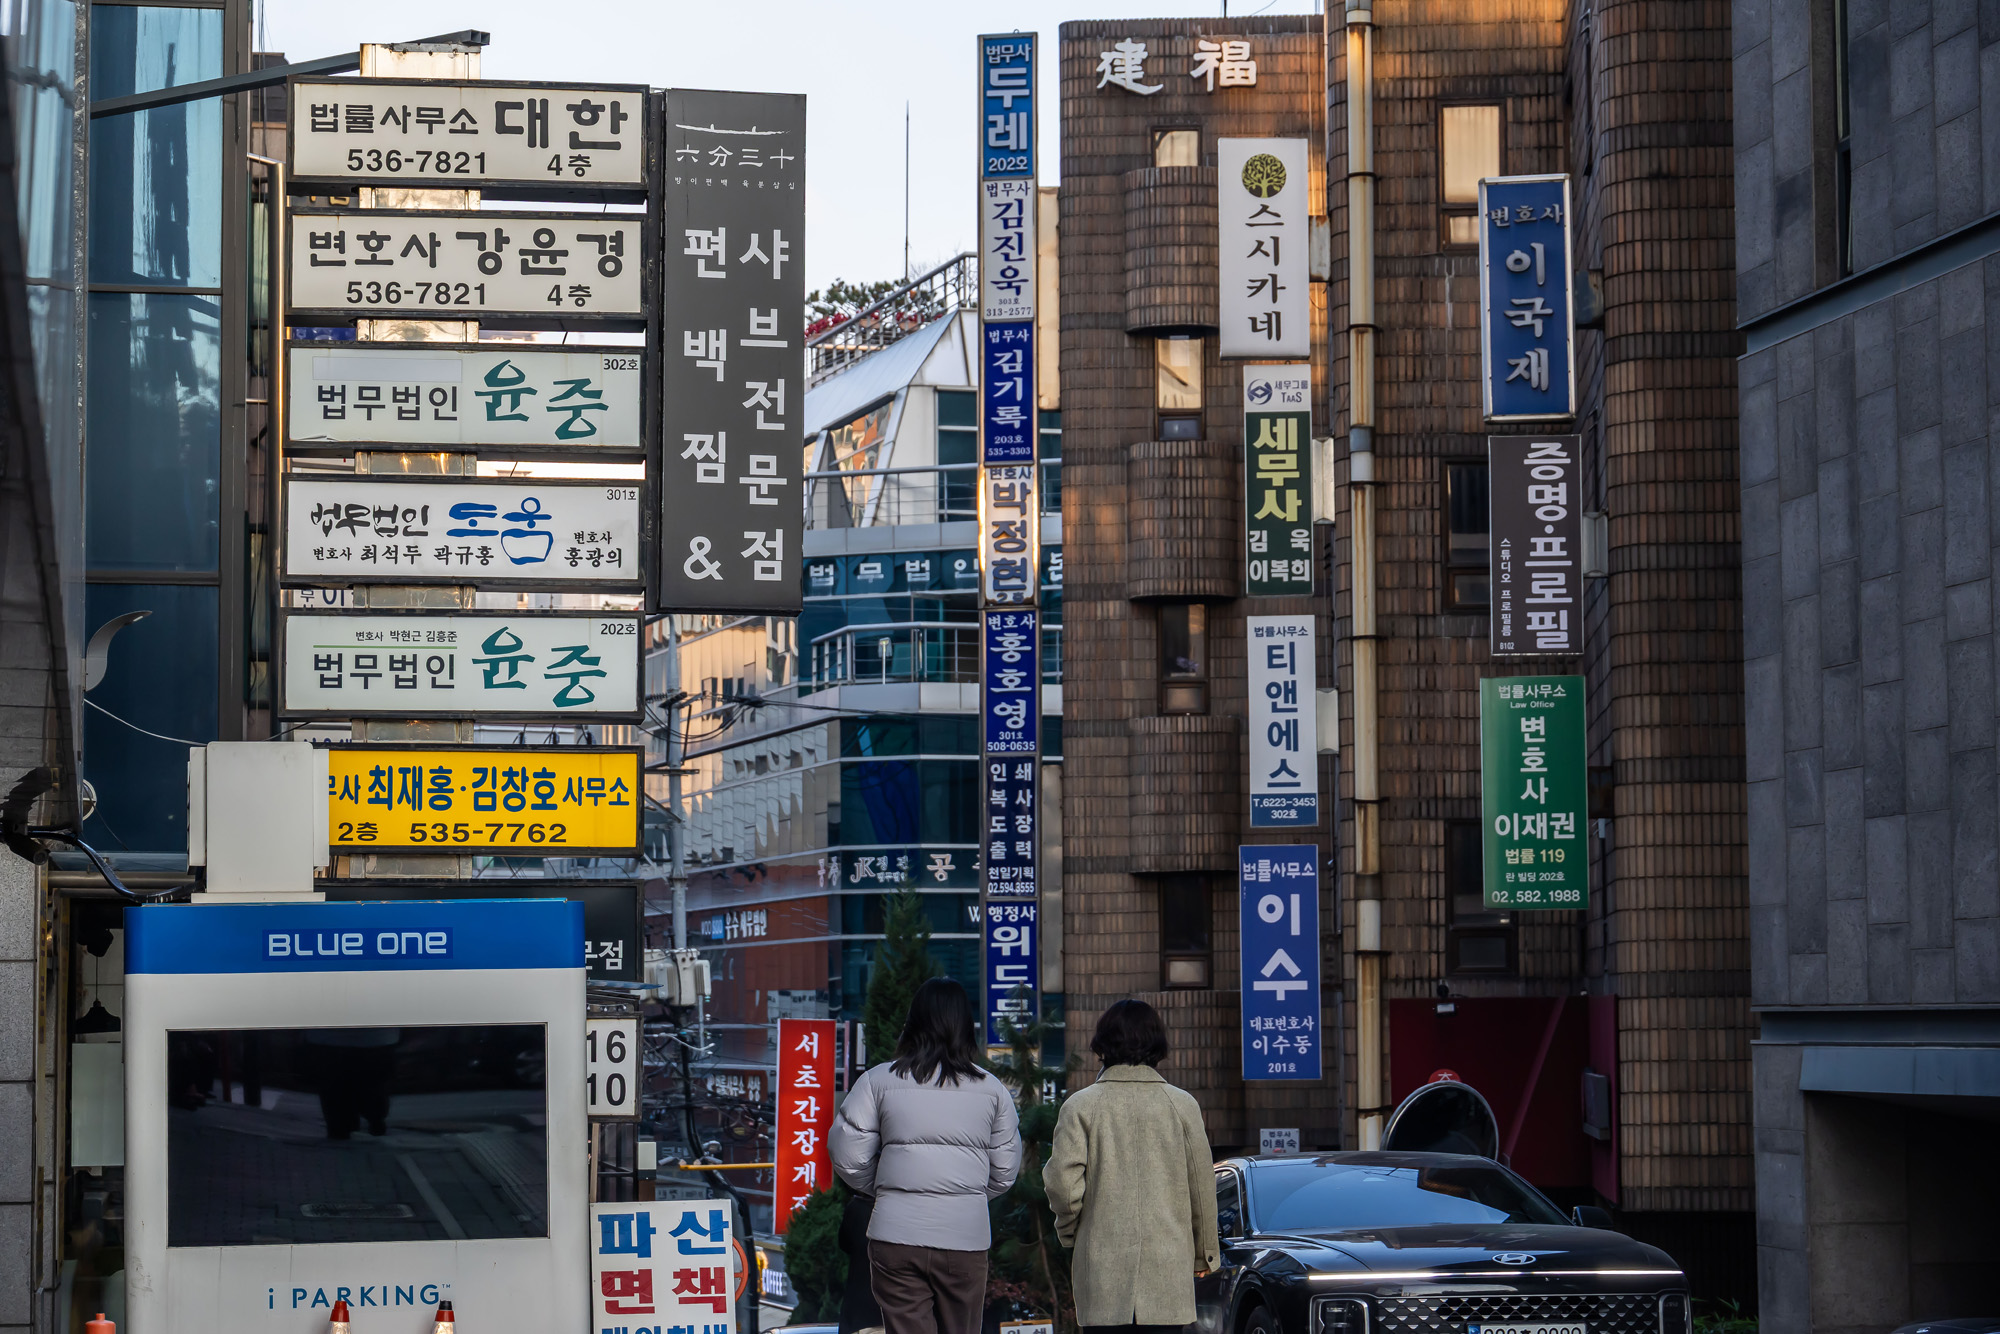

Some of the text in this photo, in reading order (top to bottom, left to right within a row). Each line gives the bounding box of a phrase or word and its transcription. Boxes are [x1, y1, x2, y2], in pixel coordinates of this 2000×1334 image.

[986, 43, 1031, 64] 법무사
[1096, 37, 1257, 96] 建福
[986, 67, 1030, 151] 두레
[310, 98, 628, 151] 법률사무소 대한
[347, 149, 486, 175] 536-7821
[547, 154, 592, 178] 4층
[675, 144, 795, 170] 六分三十
[988, 156, 1028, 172] 202호
[986, 181, 1030, 198] 법무사
[1490, 204, 1563, 227] 변호사
[309, 227, 624, 278] 변호사 강윤경
[990, 198, 1029, 297] 김진욱
[1245, 203, 1286, 341] 스시카네
[346, 281, 486, 306] 536-7821
[547, 284, 592, 308] 4층
[986, 306, 1031, 316] 313-2577
[1504, 242, 1554, 392] 이국재
[988, 329, 1029, 344] 법무사
[603, 358, 639, 371] 302호
[318, 359, 609, 440] 법무법인 윤중
[991, 349, 1028, 429] 김기록
[739, 229, 789, 581] 샤브전문점
[994, 434, 1024, 445] 203호
[988, 446, 1031, 456] 535-3303
[989, 466, 1032, 480] 변호사
[1253, 418, 1302, 522] 세무사
[606, 488, 637, 501] 301호
[311, 497, 554, 565] 법무법인 도움
[573, 531, 612, 545] 변호사
[991, 481, 1032, 591] 박정현
[313, 544, 495, 566] 변호사 최석두 곽규홍
[564, 546, 622, 568] 홍광의
[1500, 538, 1512, 583] 스튜디오
[1250, 559, 1310, 582] 이복희
[600, 623, 637, 636] 202호
[988, 613, 1036, 630] 변호사
[1254, 626, 1308, 638] 법률사무소
[355, 631, 384, 642] 변호사
[390, 629, 422, 643] 박현근
[314, 626, 607, 708] 법무법인 윤중
[990, 633, 1032, 729] 홍호영
[1498, 684, 1566, 699] 법률사무소
[1265, 641, 1301, 788] 티앤에스
[1510, 700, 1555, 709] Law Office
[987, 741, 1035, 751] 508-0635
[999, 731, 1024, 740] 301호
[1520, 716, 1549, 805] 변호사
[563, 776, 630, 806] 사무소
[1253, 798, 1316, 808] T.6223-3453
[1271, 809, 1298, 820] 302호
[338, 821, 379, 842] 2층
[409, 823, 567, 843] 535-7762
[1494, 811, 1575, 840] 이재권
[1505, 848, 1565, 864] 법률 119
[988, 866, 1034, 879] 천일기획
[1243, 858, 1315, 882] 법률사무소
[1518, 871, 1536, 882] 빌딩
[1539, 871, 1566, 881] 202호
[988, 881, 1035, 894] 02.594.3555
[1492, 890, 1580, 904] 02.582.1988
[988, 905, 1036, 922] 행정사
[1253, 894, 1308, 1001] 이수
[1250, 1016, 1314, 1032] 대표변호사
[1252, 1035, 1312, 1055] 이수동
[1268, 1062, 1296, 1073] 201호
